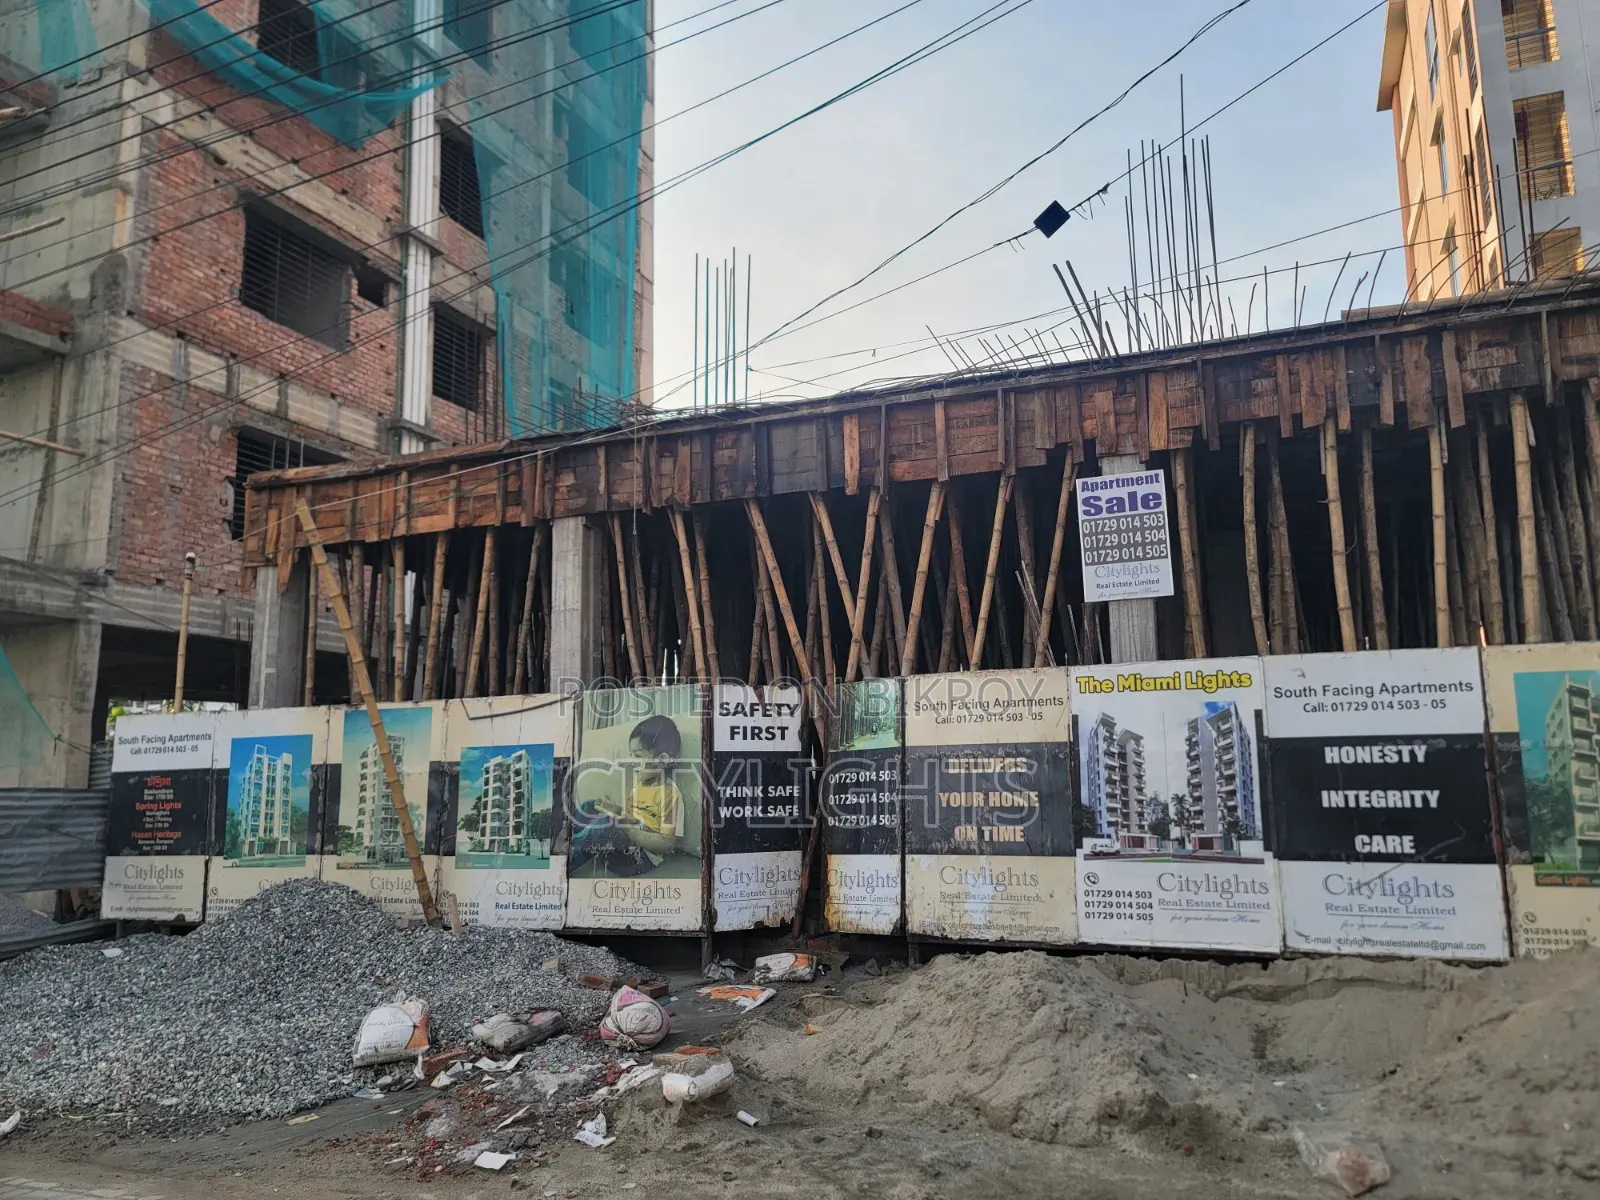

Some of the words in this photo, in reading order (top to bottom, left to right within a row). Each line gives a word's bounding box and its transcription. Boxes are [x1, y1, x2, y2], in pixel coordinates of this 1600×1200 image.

[1081, 473, 1160, 492] Apartment
[1082, 491, 1162, 516] Sale
[1083, 519, 1117, 533] 01729
[1120, 516, 1140, 530] 014
[1144, 514, 1164, 527] 503
[1084, 534, 1118, 548] 01729
[1121, 532, 1142, 545] 014
[1145, 529, 1166, 542] 504
[1086, 549, 1119, 563] 01729
[1122, 547, 1143, 560] 014
[1146, 544, 1167, 558] 505
[1094, 563, 1160, 579] Citylights
[1096, 581, 1110, 589] Real
[1076, 676, 1114, 694] The
[1117, 672, 1181, 692] Miami
[1186, 670, 1252, 694] Lights
[1274, 686, 1317, 698] South
[1322, 684, 1374, 698] Facing
[1378, 680, 1474, 697] Apartments
[718, 702, 799, 718] SAFETY
[914, 702, 946, 712] South
[951, 699, 989, 711] Facing
[993, 696, 1064, 709] Apartments
[1303, 702, 1328, 712] Call:
[1331, 702, 1368, 712] 01729
[1371, 700, 1394, 710] 014
[1398, 700, 1420, 710] 503
[1431, 699, 1446, 710] 05
[936, 716, 954, 724] Call:
[956, 714, 984, 723] 01729
[986, 714, 1004, 722] 014
[1006, 713, 1023, 722] 503
[1032, 712, 1043, 721] 05
[118, 736, 138, 745] South
[141, 734, 166, 745] Facing
[168, 732, 212, 743] Apartments
[730, 726, 789, 740] FIRST
[1324, 745, 1427, 764] HONESTY
[949, 758, 1028, 774] DELIVERS
[828, 772, 857, 784] 01729
[859, 772, 876, 782] 014
[878, 770, 896, 781] 503
[718, 786, 763, 798] THINK
[768, 786, 800, 796] SAFE
[828, 794, 857, 804] 01729
[860, 792, 877, 804] 014
[879, 792, 897, 803] 504
[939, 792, 984, 808] YOUR
[988, 792, 1039, 807] HOME
[1321, 790, 1440, 808] INTEGRITY
[160, 802, 182, 810] Lights
[718, 806, 763, 818] WORK
[768, 805, 800, 816] SAFE
[828, 816, 857, 826] 01729
[859, 815, 877, 826] 014
[879, 815, 897, 825] 505
[954, 826, 978, 842] ON
[982, 826, 1024, 842] TIME
[1354, 834, 1416, 854] CARE
[124, 864, 184, 884] Citylights
[719, 865, 800, 888] Citylights
[826, 868, 898, 894] Citylights
[940, 866, 1038, 892] Citylights
[496, 880, 564, 900] Citylights
[593, 880, 682, 906] Citylights
[1084, 890, 1112, 898] 01729
[1115, 890, 1132, 898] 014
[1136, 890, 1152, 898] 503
[1156, 872, 1269, 900] Citylights
[1322, 874, 1454, 904] Citylights
[718, 891, 736, 899] Real
[740, 890, 766, 898] Estate
[844, 894, 866, 902] Estate
[870, 895, 898, 903] Limited
[940, 892, 960, 900] Real
[964, 892, 996, 900] Estate
[1000, 893, 1039, 902] Limited
[535, 902, 562, 910] Limited
[592, 904, 610, 912] Real
[614, 906, 642, 914] Estate
[646, 906, 681, 914] Limited
[1084, 900, 1113, 908] 01729
[1116, 901, 1134, 909] 014
[1136, 902, 1153, 910] 504
[1158, 898, 1182, 907] Real
[1186, 900, 1222, 908] Estate
[1226, 900, 1270, 910] Limited
[1325, 902, 1352, 912] Real
[1358, 904, 1400, 914] Estate
[1405, 904, 1456, 916] Limited
[1085, 912, 1114, 920] 01729
[1116, 912, 1134, 920] 014
[1136, 912, 1154, 920] 505
[1170, 914, 1182, 922] for
[1304, 936, 1332, 944] E-mail
